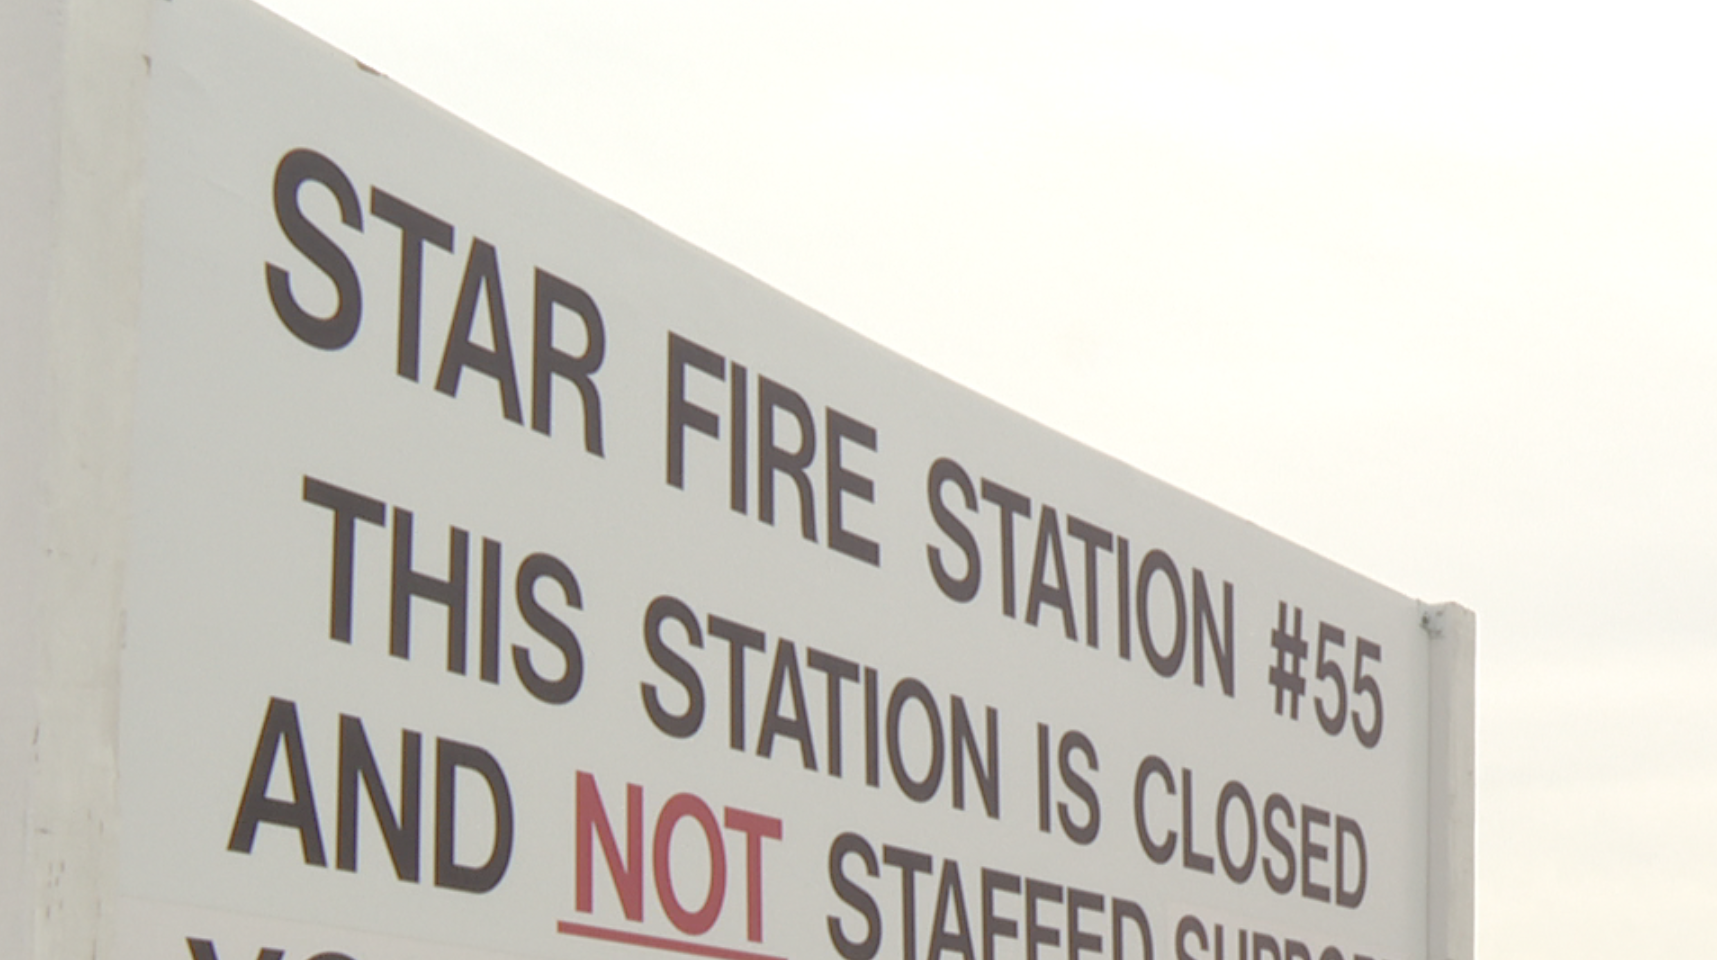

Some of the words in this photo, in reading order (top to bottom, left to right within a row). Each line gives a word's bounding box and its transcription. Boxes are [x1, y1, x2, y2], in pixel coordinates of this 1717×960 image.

[265, 148, 605, 457] STAR
[666, 331, 880, 567] FIRE
[926, 457, 1235, 698] STATION
[1269, 600, 1384, 749] #55
[227, 696, 515, 895] AND
[574, 770, 783, 944] NOT
[302, 475, 585, 705] THIS
[640, 595, 1000, 820] STATION
[1037, 722, 1101, 846] IS
[1134, 755, 1368, 909] CLOSED
